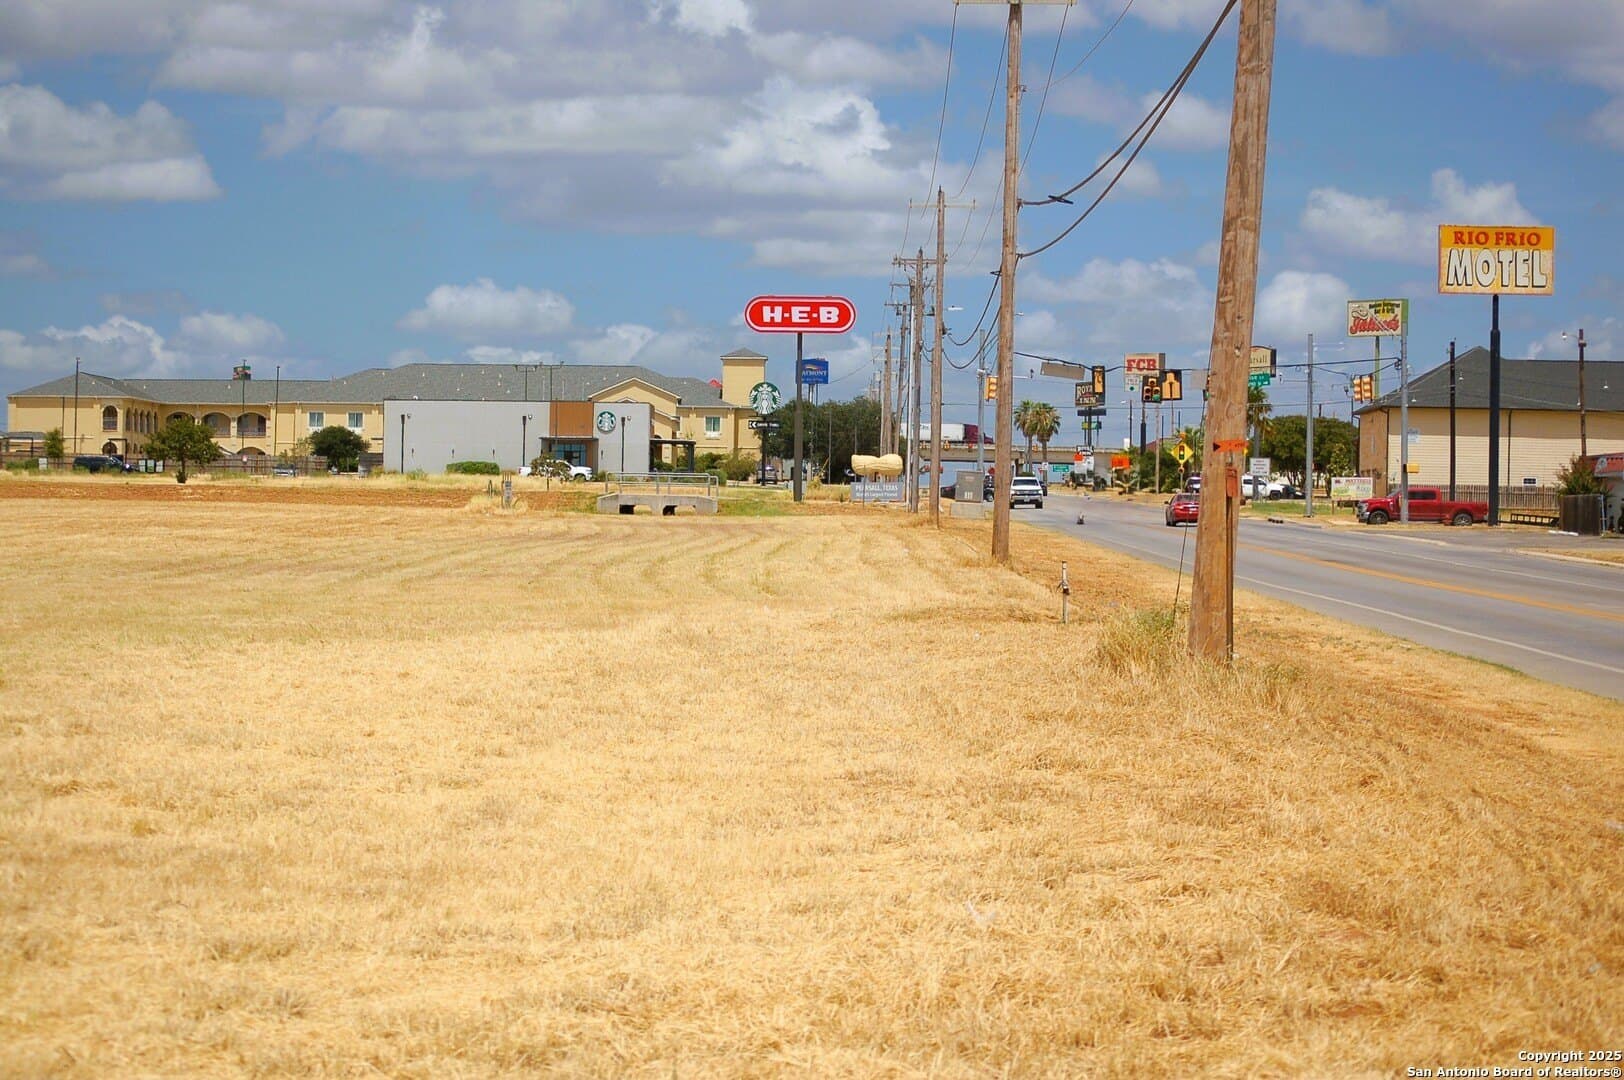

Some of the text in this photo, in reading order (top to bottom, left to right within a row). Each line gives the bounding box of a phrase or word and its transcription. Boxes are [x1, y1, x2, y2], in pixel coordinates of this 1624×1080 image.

[1453, 231, 1541, 246] RIO FRIO
[1446, 248, 1548, 288] MOTEL
[762, 306, 840, 323] H-E-B
[1126, 359, 1157, 371] FCB
[801, 369, 827, 377] AYMONT
